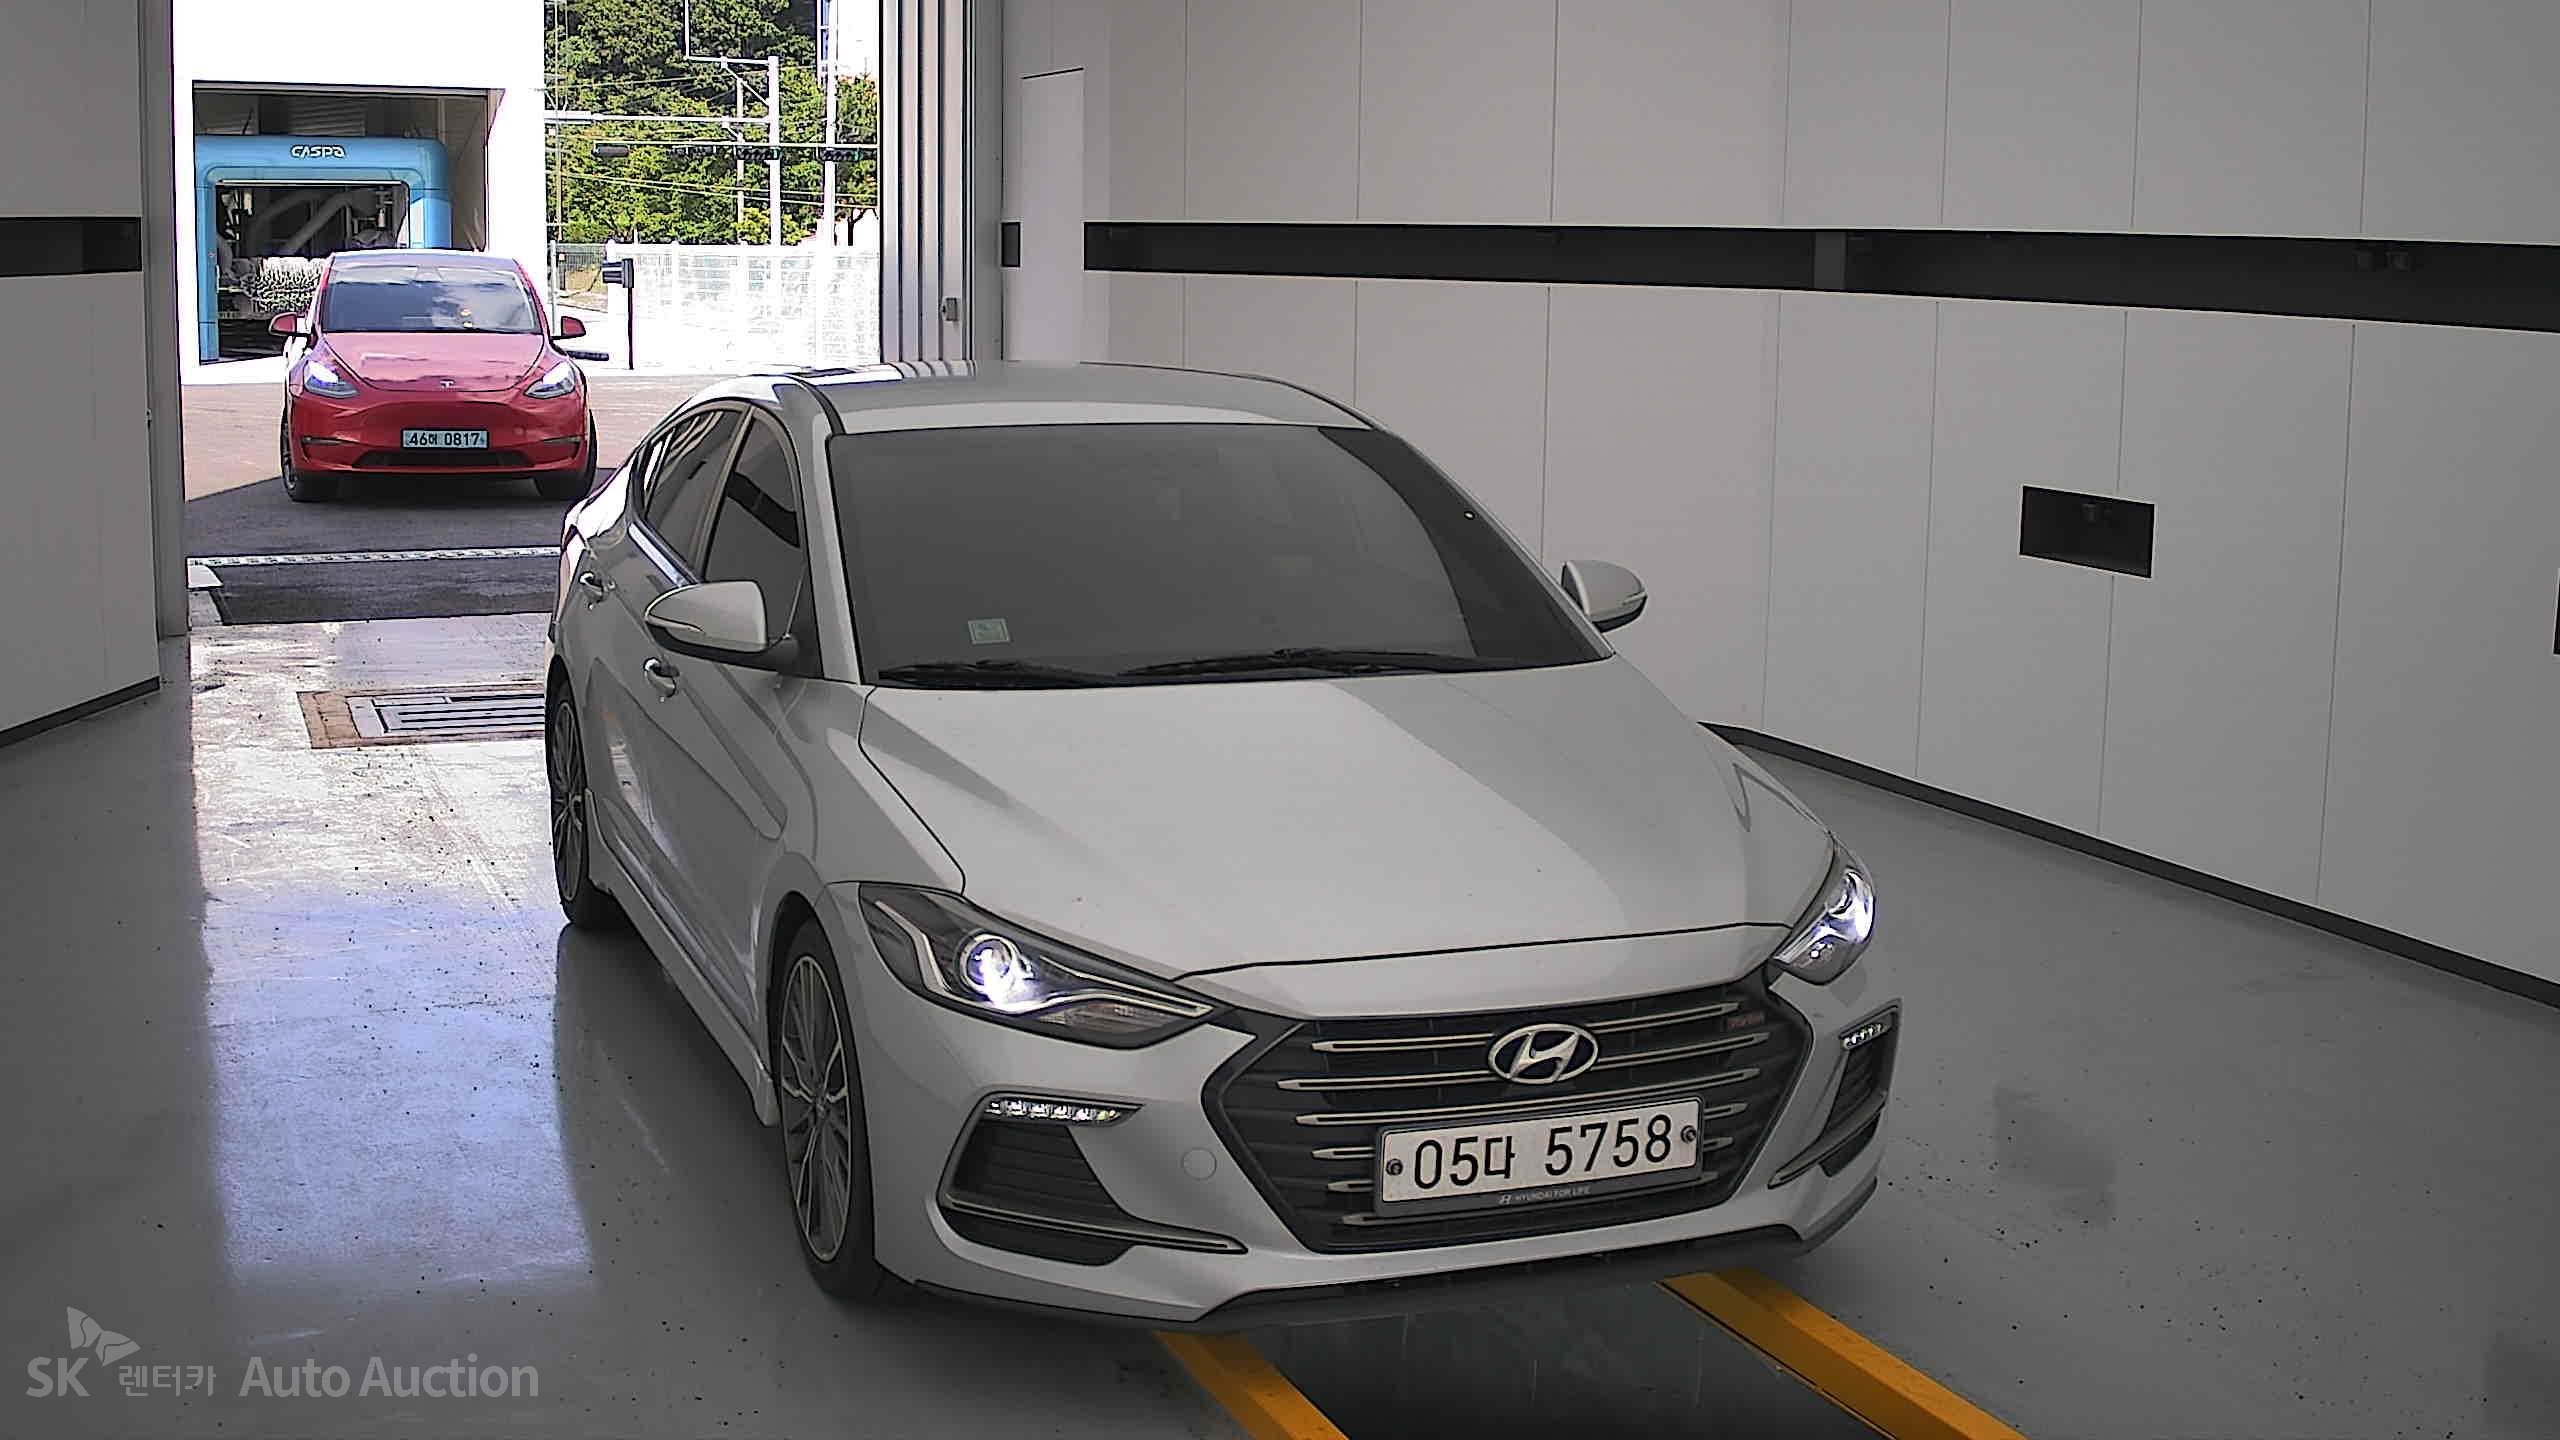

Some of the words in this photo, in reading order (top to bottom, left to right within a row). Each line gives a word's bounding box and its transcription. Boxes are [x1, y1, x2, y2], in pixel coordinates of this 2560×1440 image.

[444, 432, 481, 446] 0817
[1413, 1135, 1516, 1190] 05다
[1544, 1113, 1673, 1177] 5758
